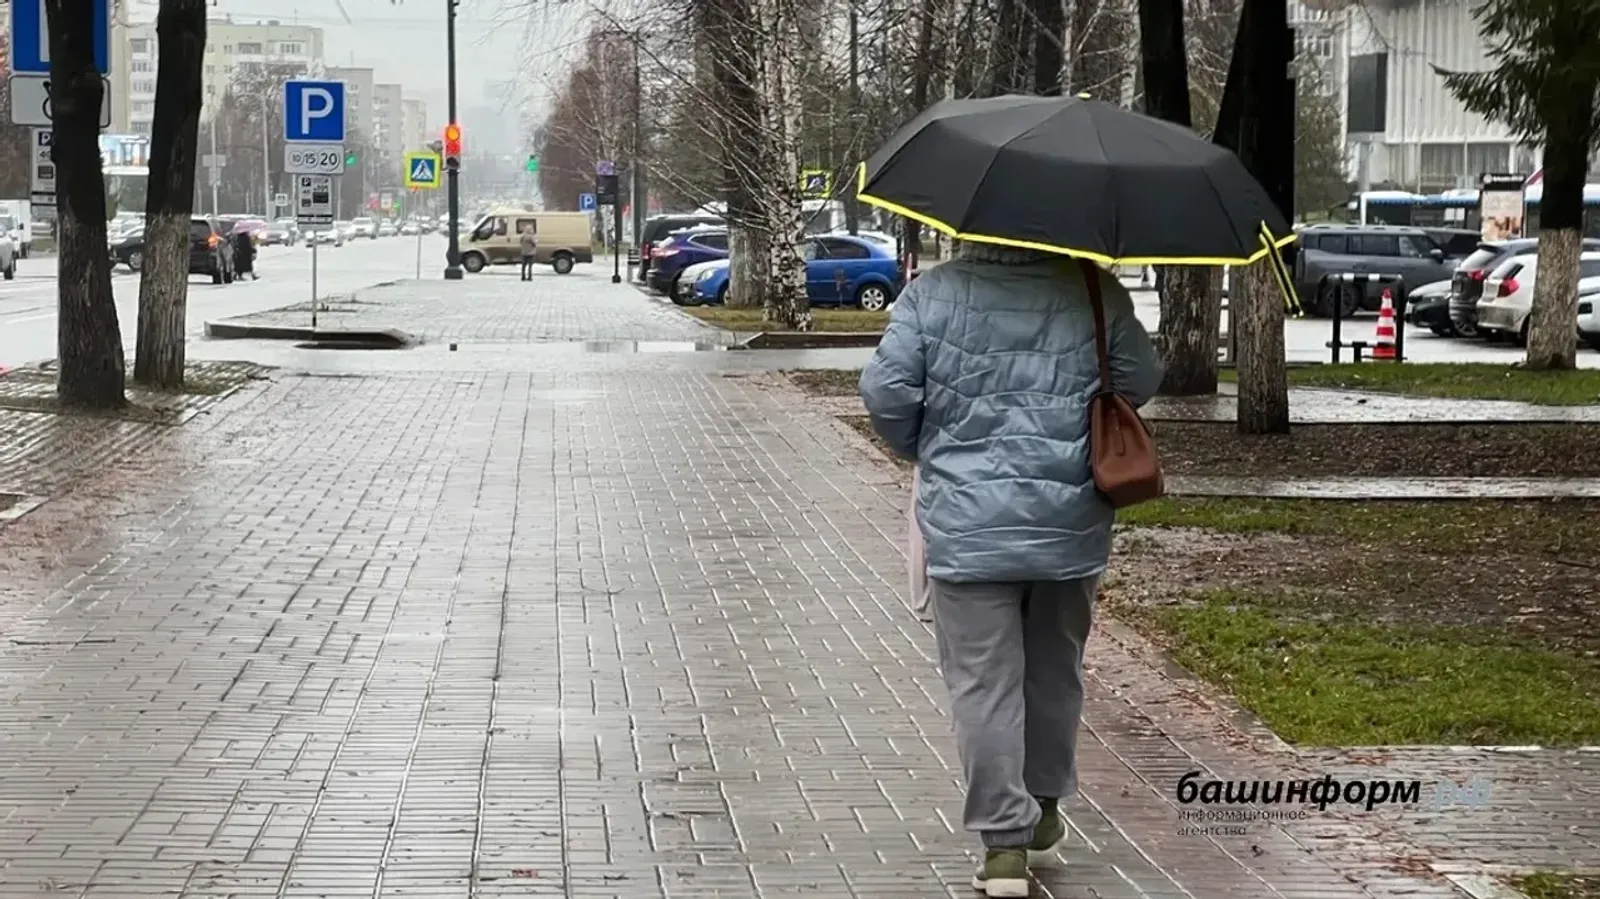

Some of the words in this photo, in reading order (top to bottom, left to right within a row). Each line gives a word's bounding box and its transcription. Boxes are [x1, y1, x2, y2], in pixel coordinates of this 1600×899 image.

[301, 87, 334, 134] P
[304, 153, 316, 164] 15
[320, 153, 338, 165] 20
